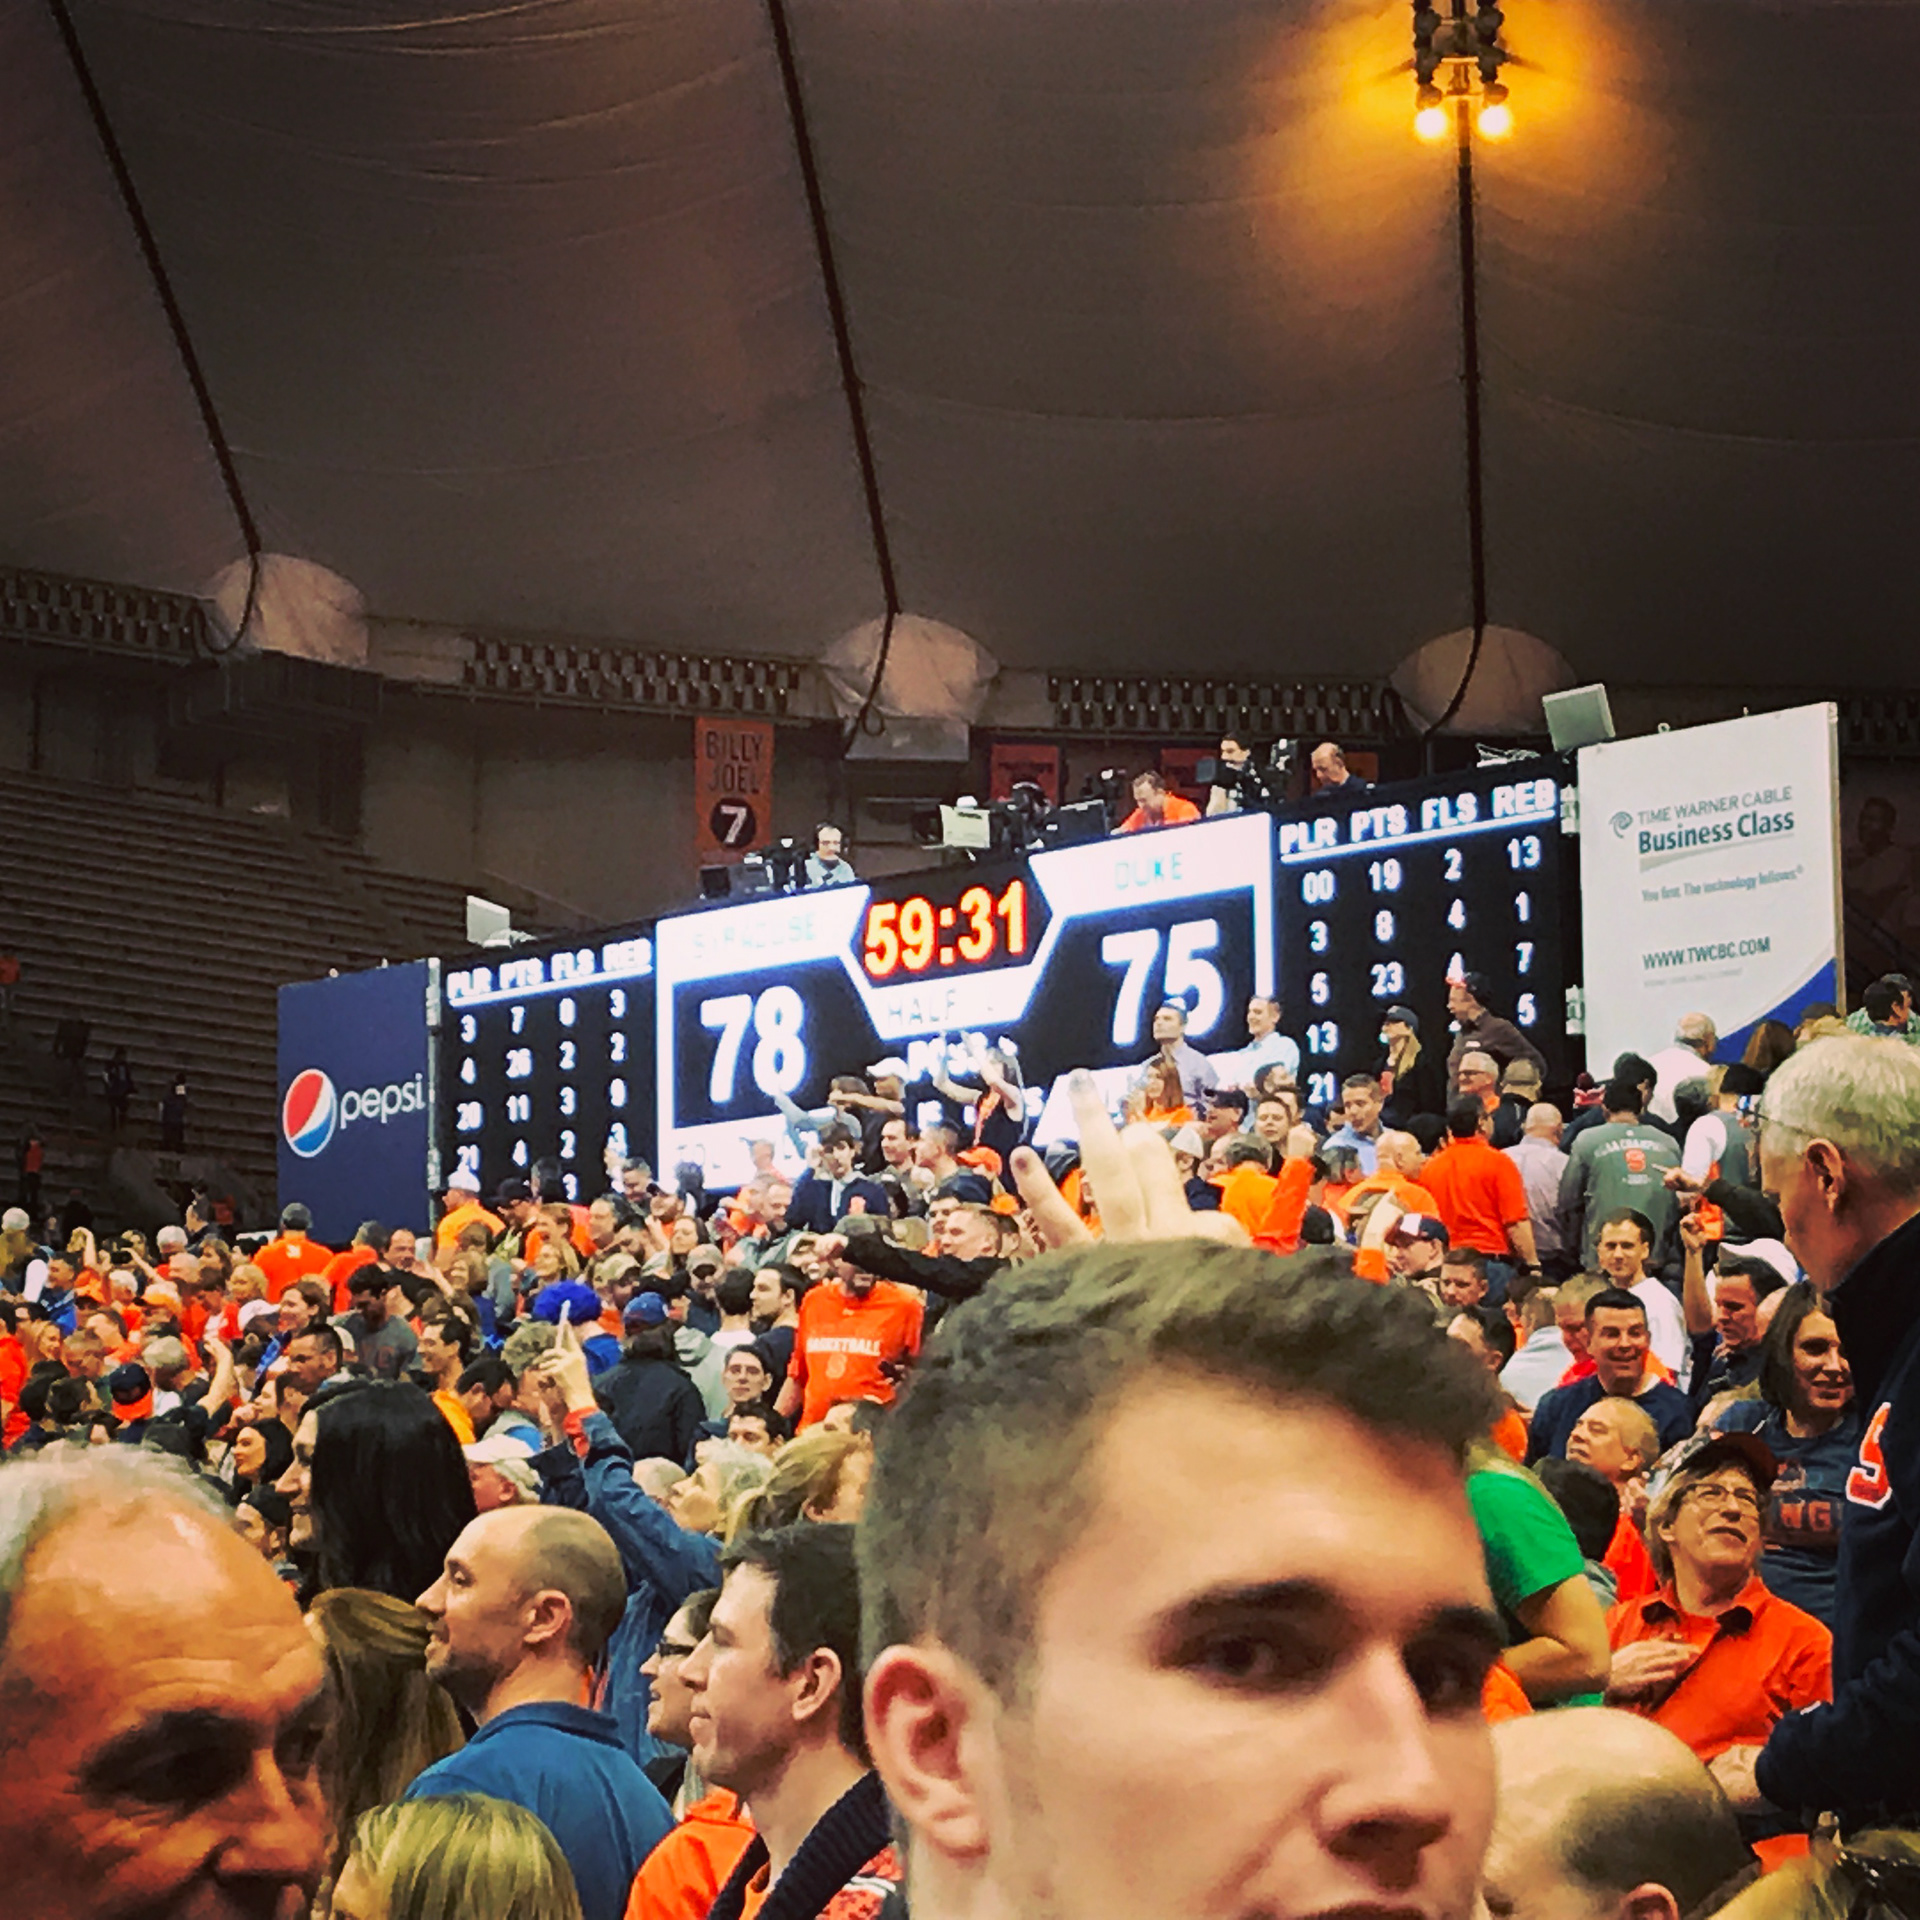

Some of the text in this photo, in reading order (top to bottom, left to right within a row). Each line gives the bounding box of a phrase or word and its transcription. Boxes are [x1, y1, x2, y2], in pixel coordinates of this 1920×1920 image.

[706, 730, 764, 762] BILLY
[707, 763, 761, 794] JOEL
[720, 805, 748, 844] 7
[1279, 778, 1557, 855] PLR PTS FLS REB
[1638, 786, 1793, 825] TIME WARNER CABLE
[1639, 810, 1794, 854] Business Class
[1115, 851, 1184, 891] DUKE
[1302, 835, 1541, 904] 00 19 2 13
[863, 879, 1026, 978] 59:31
[1309, 891, 1530, 952] 3 8 4 1
[500, 957, 543, 989] PTS
[552, 949, 595, 981] FLS
[1371, 961, 1404, 996] 23
[1516, 941, 1534, 974] 7
[1642, 936, 1771, 970] WWW.TWCBC.COM
[1101, 918, 1225, 1046] 75
[460, 1014, 476, 1043] 3
[511, 1006, 525, 1034] 7
[610, 989, 625, 1017] 3
[888, 988, 956, 1025] HALF
[1306, 993, 1536, 1053] 13 5
[560, 1041, 575, 1069] 2
[610, 1032, 626, 1061] 2
[700, 986, 807, 1104] 78
[340, 1073, 426, 1129] pepsi
[506, 1094, 530, 1122] 11
[560, 1086, 576, 1115] 3
[1307, 1071, 1335, 1105] 21
[456, 1144, 479, 1171] 21
[560, 1129, 576, 1159] 2
